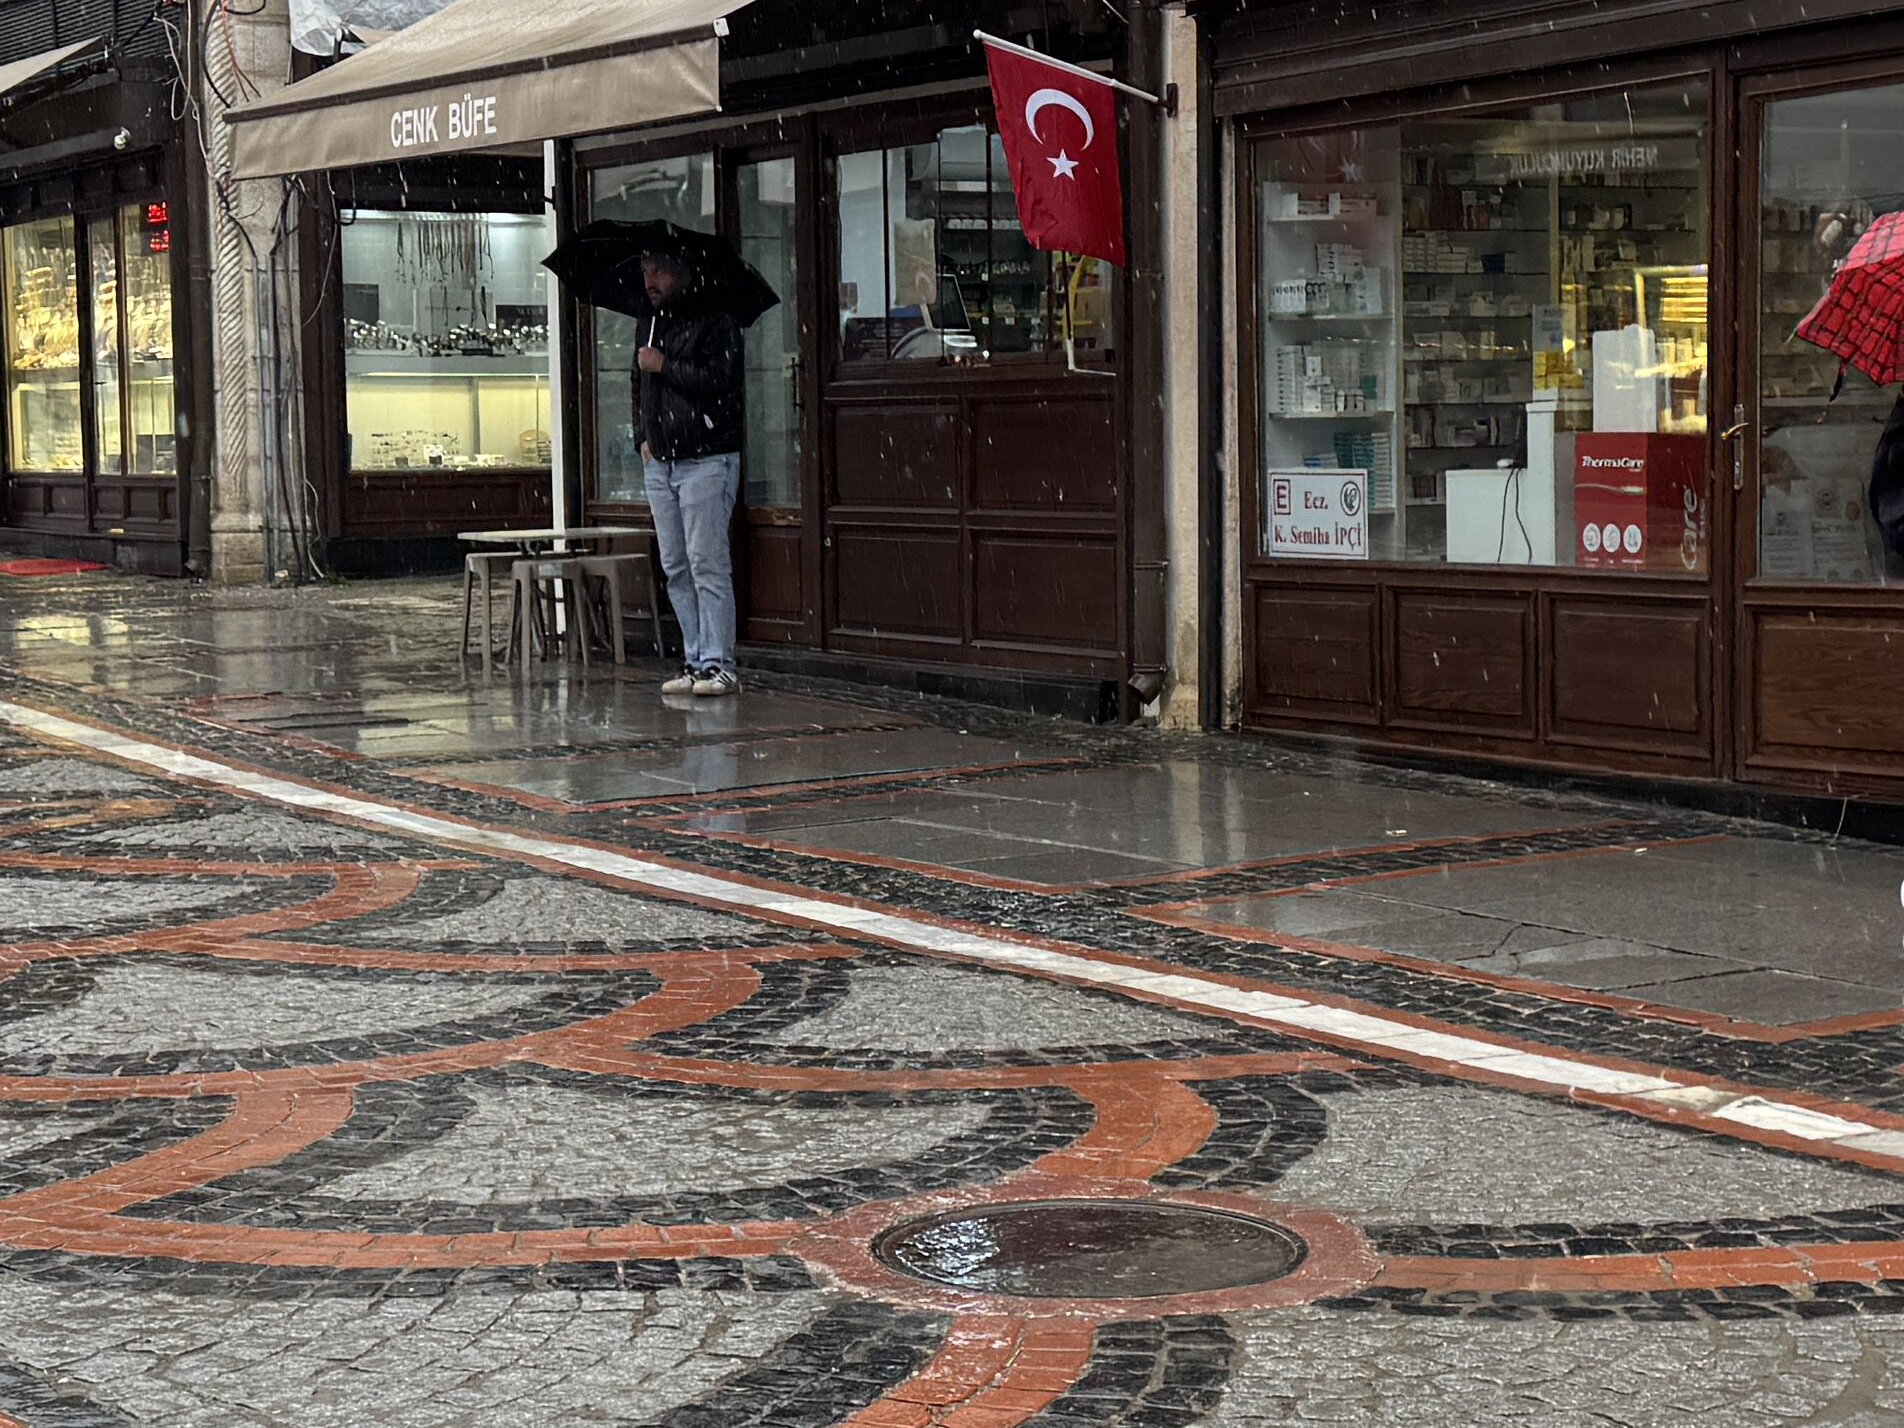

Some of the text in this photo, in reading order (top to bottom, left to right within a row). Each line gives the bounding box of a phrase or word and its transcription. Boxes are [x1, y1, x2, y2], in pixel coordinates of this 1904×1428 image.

[390, 93, 497, 148] CENK BÜFE
[1276, 485, 1328, 510] E Ecz.
